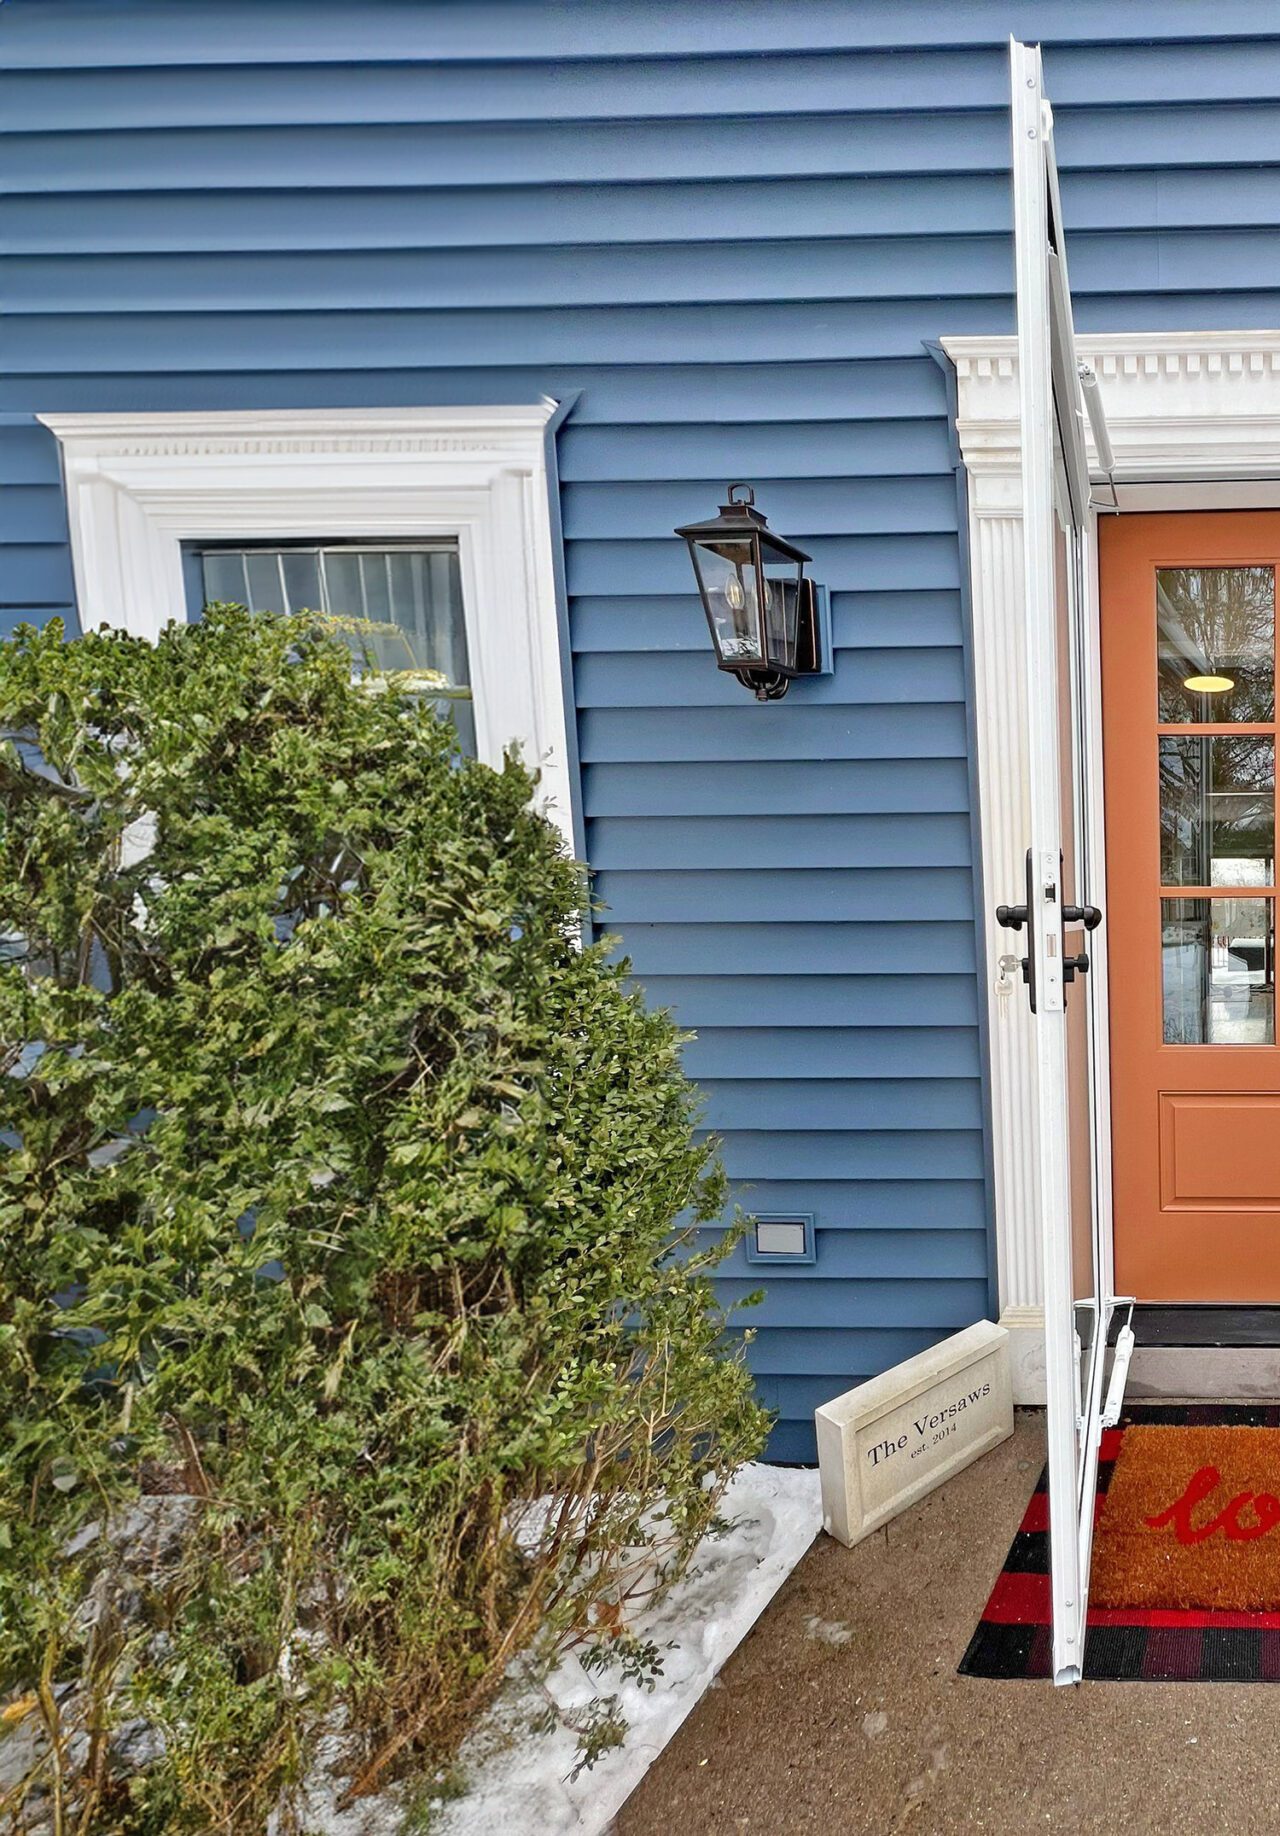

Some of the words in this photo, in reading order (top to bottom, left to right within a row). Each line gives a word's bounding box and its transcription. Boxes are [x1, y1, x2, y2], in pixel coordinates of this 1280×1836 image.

[867, 1435, 908, 1467] The
[913, 1382, 991, 1436] Versaws
[910, 1443, 930, 1459] est.
[933, 1423, 957, 1445] 2014
